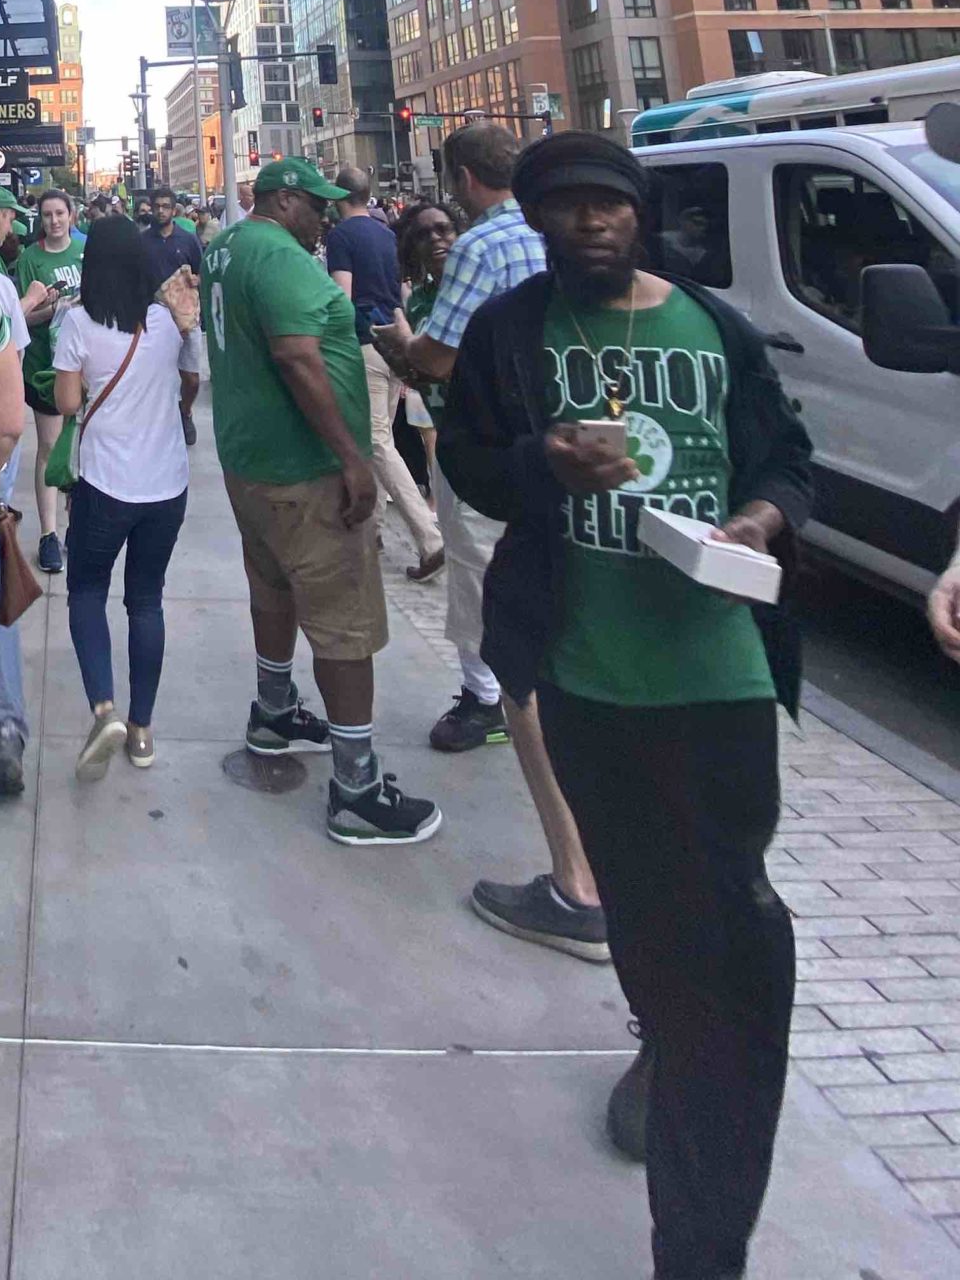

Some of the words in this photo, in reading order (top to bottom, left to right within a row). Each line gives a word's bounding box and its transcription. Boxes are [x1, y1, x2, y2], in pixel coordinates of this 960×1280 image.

[29, 169, 41, 183] P
[54, 264, 82, 288] NBA
[211, 281, 226, 351] 0
